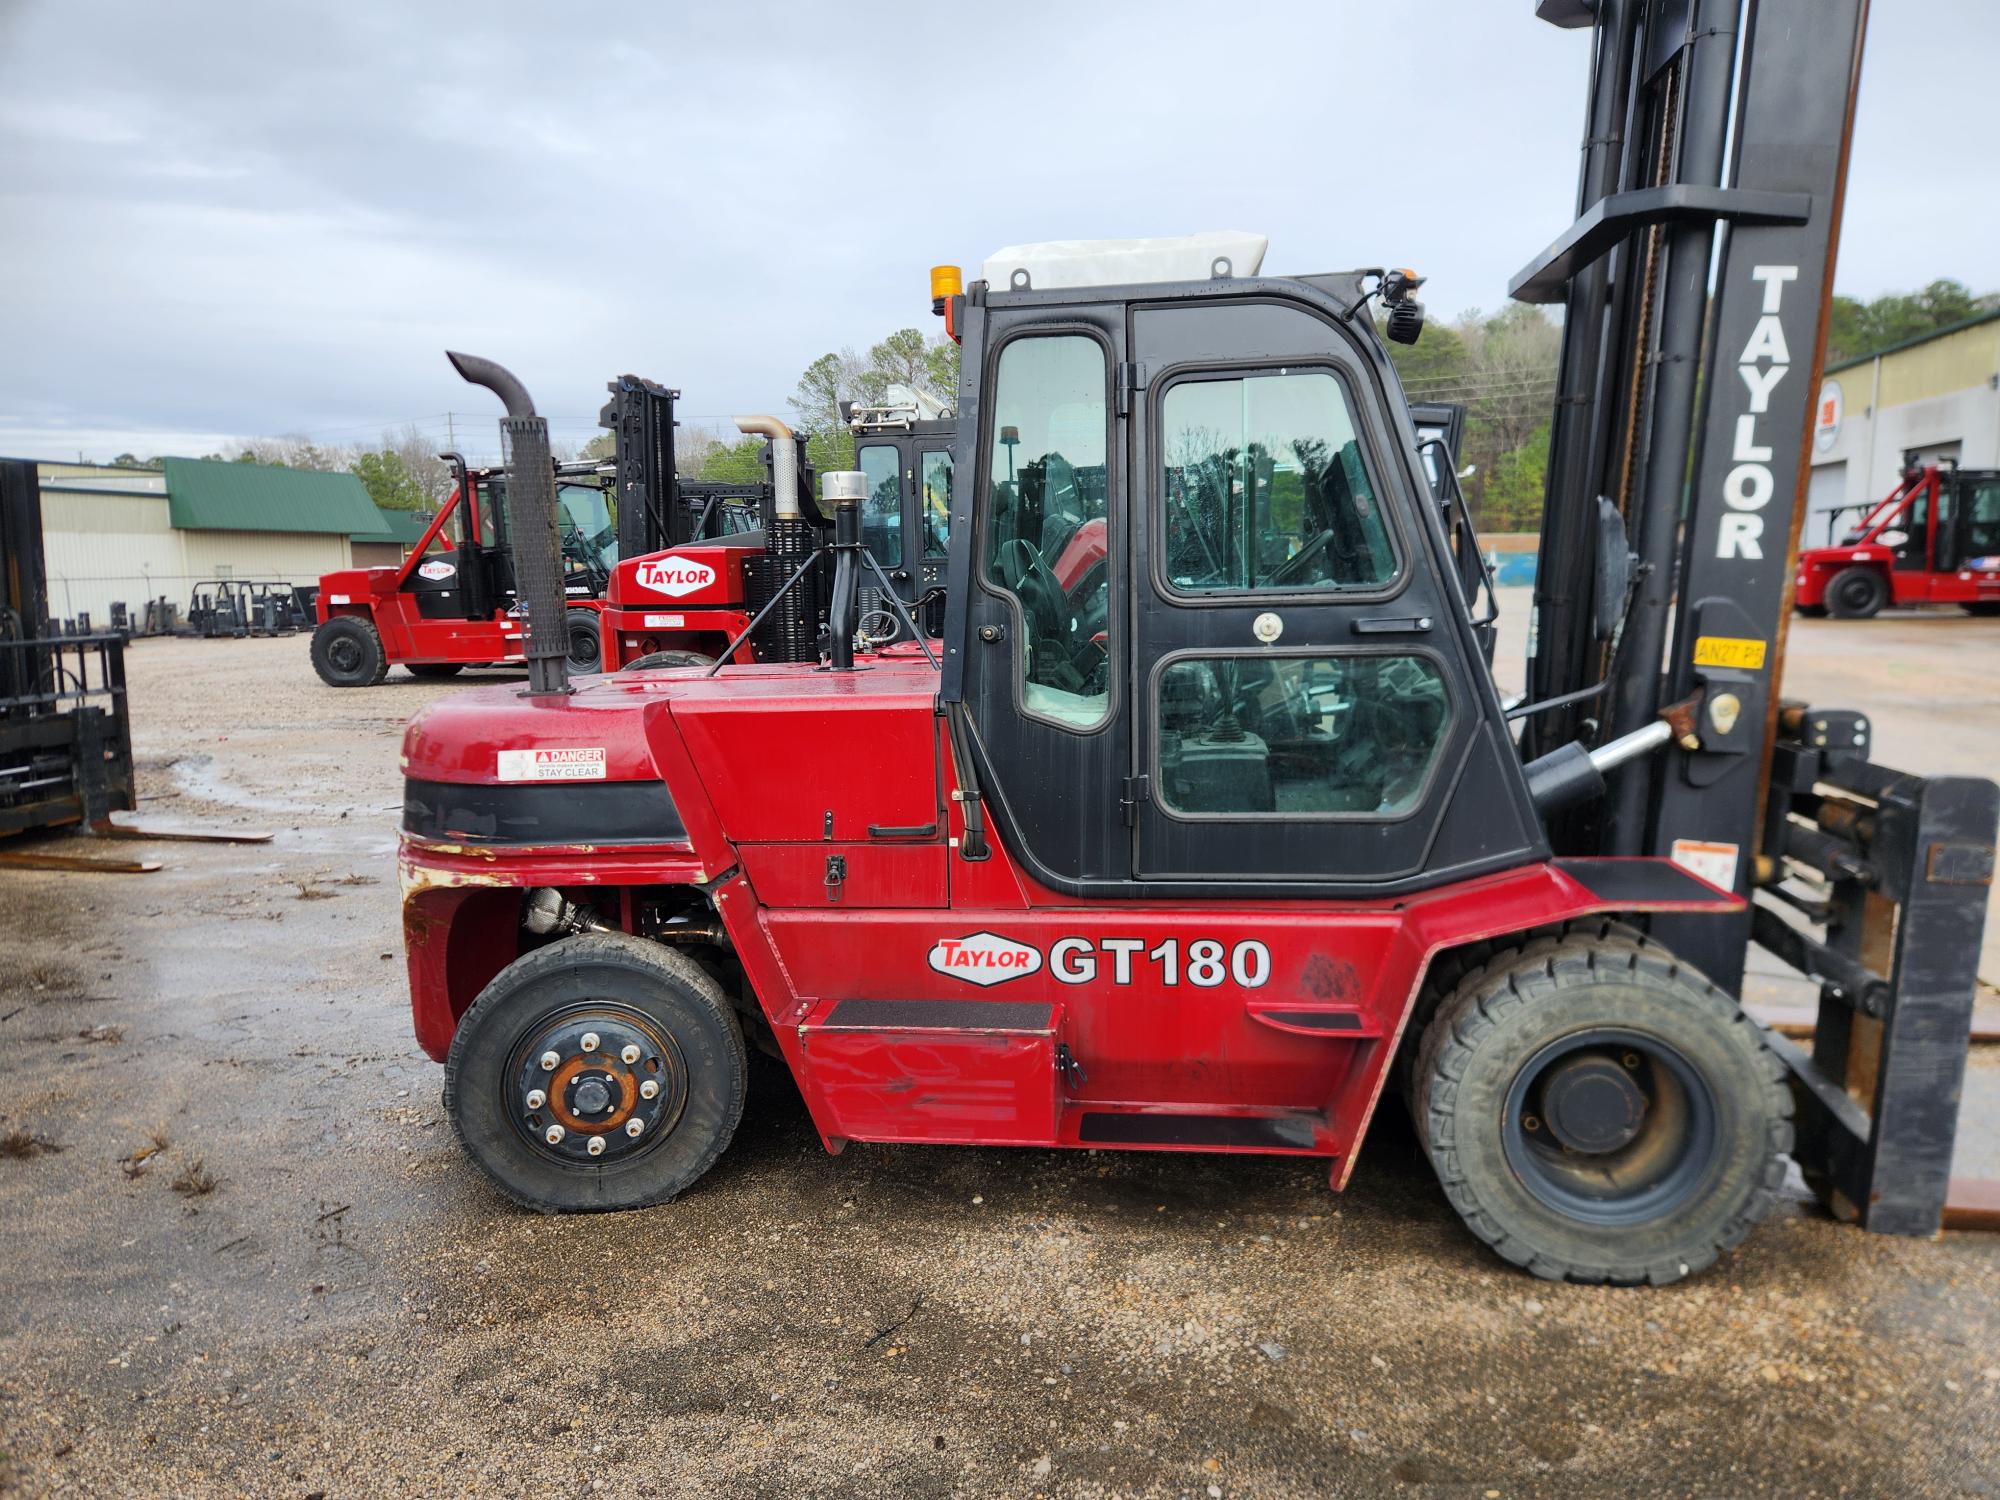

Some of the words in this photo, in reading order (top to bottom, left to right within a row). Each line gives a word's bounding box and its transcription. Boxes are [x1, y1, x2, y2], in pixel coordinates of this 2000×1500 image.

[1716, 265, 1798, 560] TAYLOR
[641, 563, 709, 585] TAYLOR
[551, 750, 602, 762] DANGER
[538, 768, 562, 778] STAY
[565, 766, 599, 777] CLEAR
[941, 942, 1030, 968] TAYLOR
[1048, 936, 1271, 988] GT180
